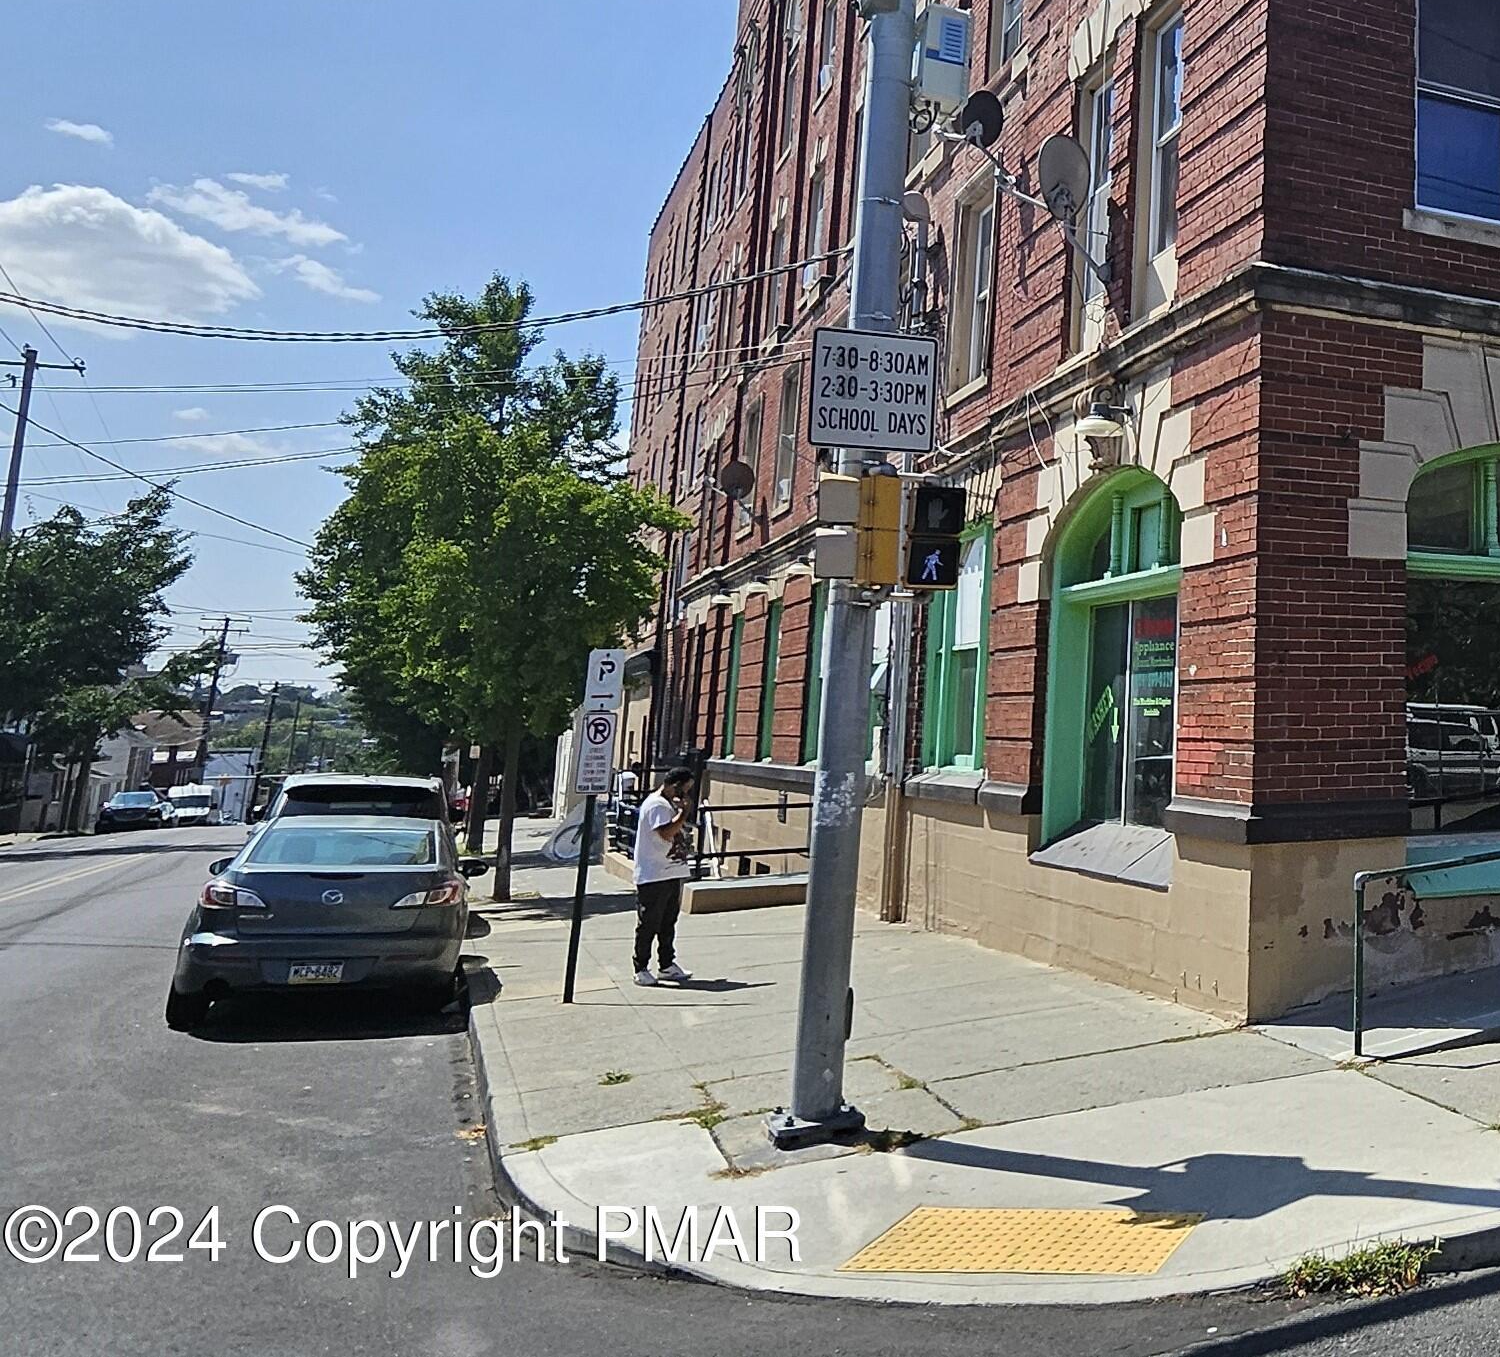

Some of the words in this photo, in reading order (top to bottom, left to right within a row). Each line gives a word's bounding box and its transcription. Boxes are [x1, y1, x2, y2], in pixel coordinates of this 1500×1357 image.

[821, 345, 929, 376] 7:30-8:30AM
[820, 375, 927, 406] 2:30-3:30PM
[818, 407, 879, 433] SCHOOL
[888, 412, 926, 436] DAYS
